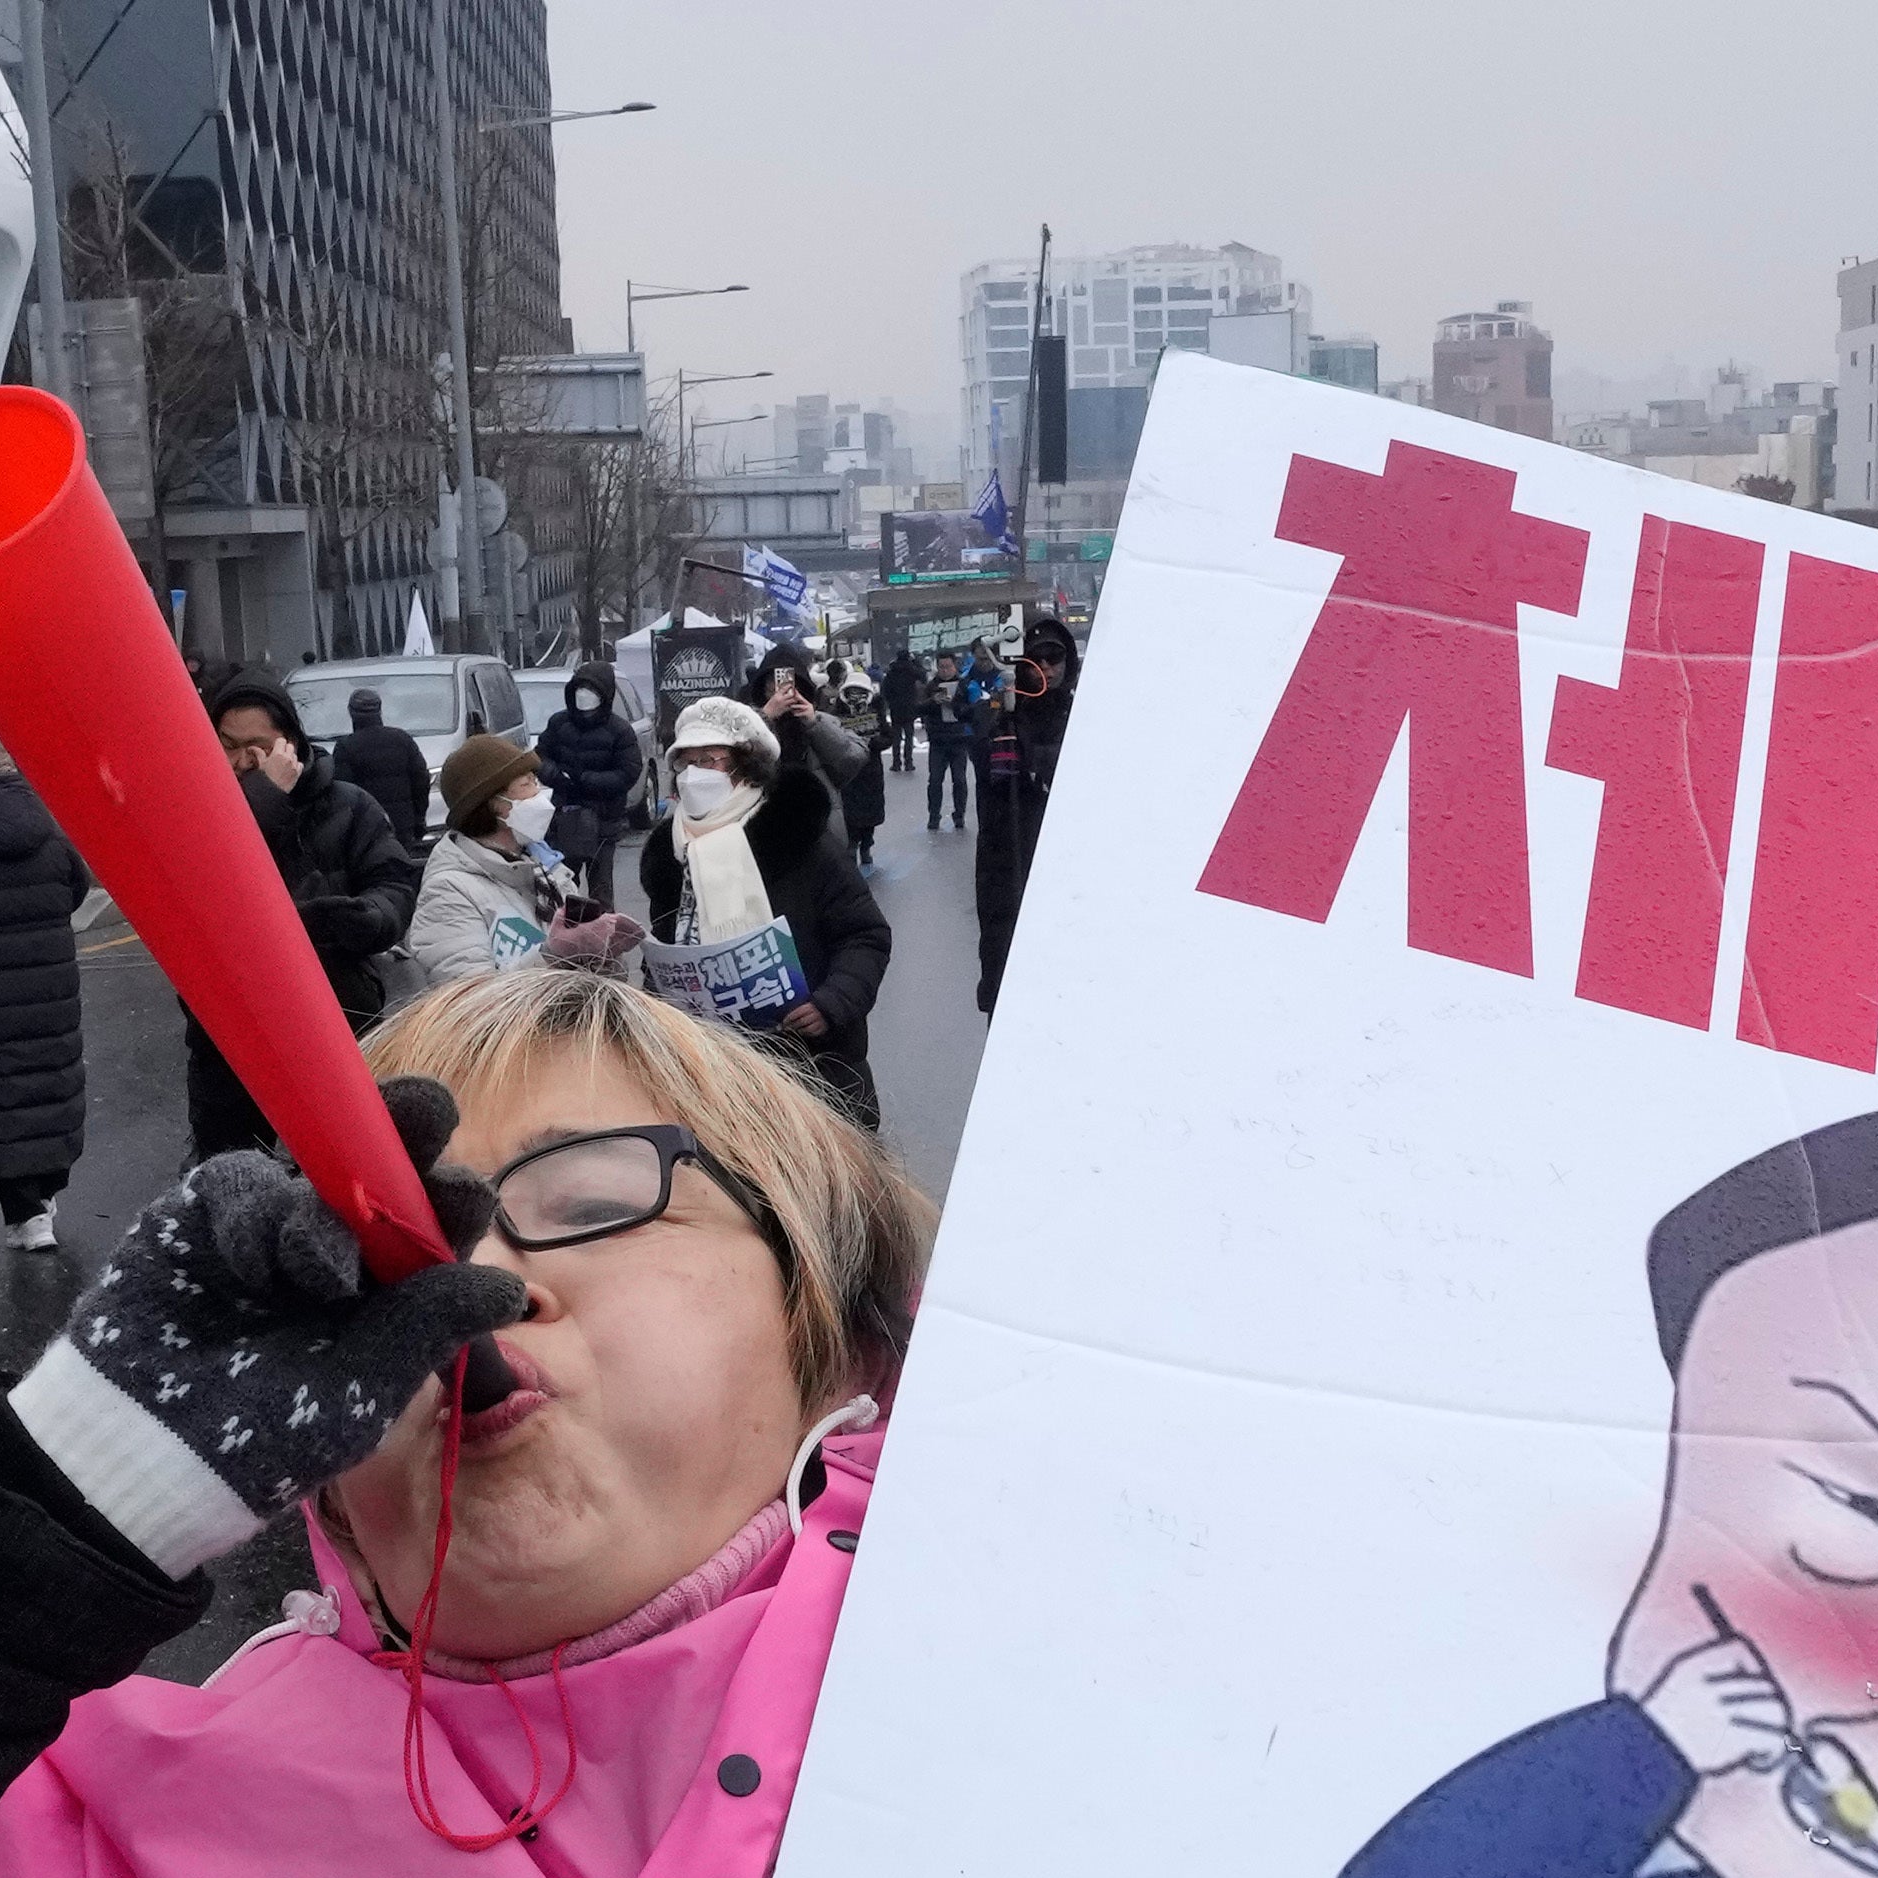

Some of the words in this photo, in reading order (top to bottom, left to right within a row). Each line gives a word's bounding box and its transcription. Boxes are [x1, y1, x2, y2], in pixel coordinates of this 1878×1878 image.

[659, 676, 732, 691] AMAZINGDAY
[699, 928, 783, 990] 체포!
[714, 965, 796, 1022] 구속!
